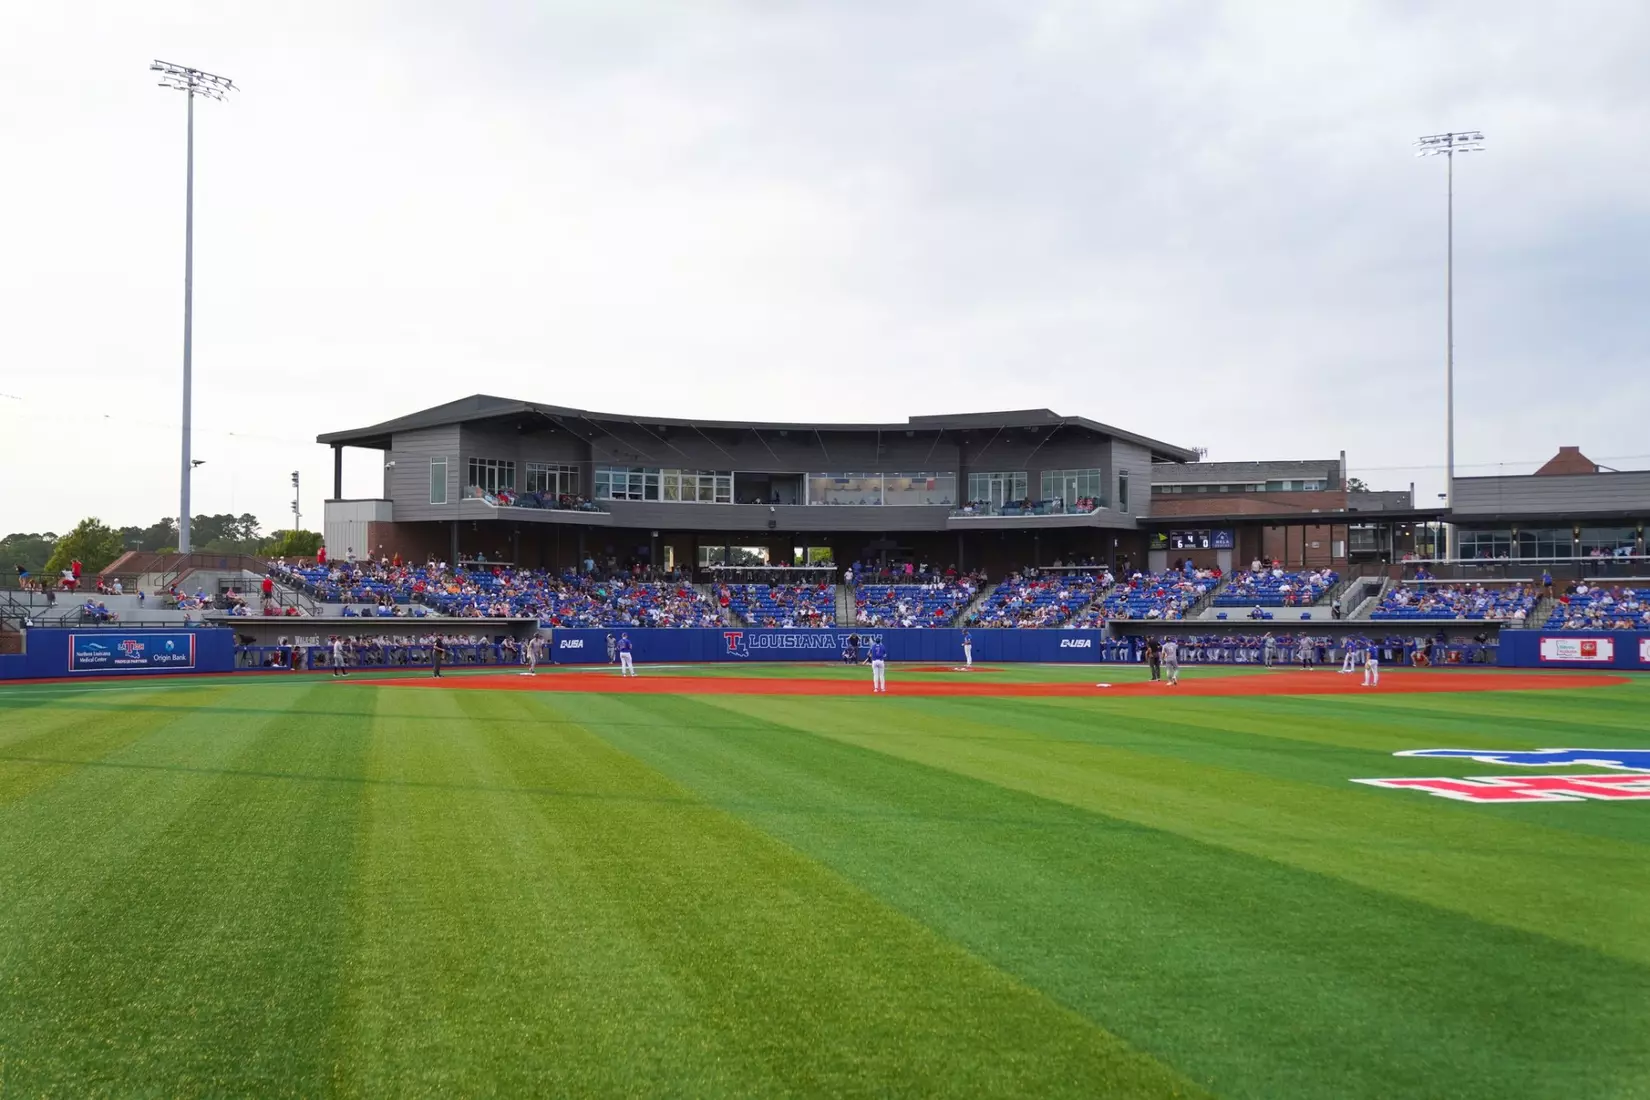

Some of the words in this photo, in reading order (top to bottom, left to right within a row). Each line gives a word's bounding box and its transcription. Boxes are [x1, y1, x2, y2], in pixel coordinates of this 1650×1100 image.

[1177, 540, 1183, 548] 6
[1203, 539, 1208, 548] 0
[749, 634, 836, 648] LOUISIANA
[838, 634, 882, 648] TCH
[153, 654, 171, 662] Origin
